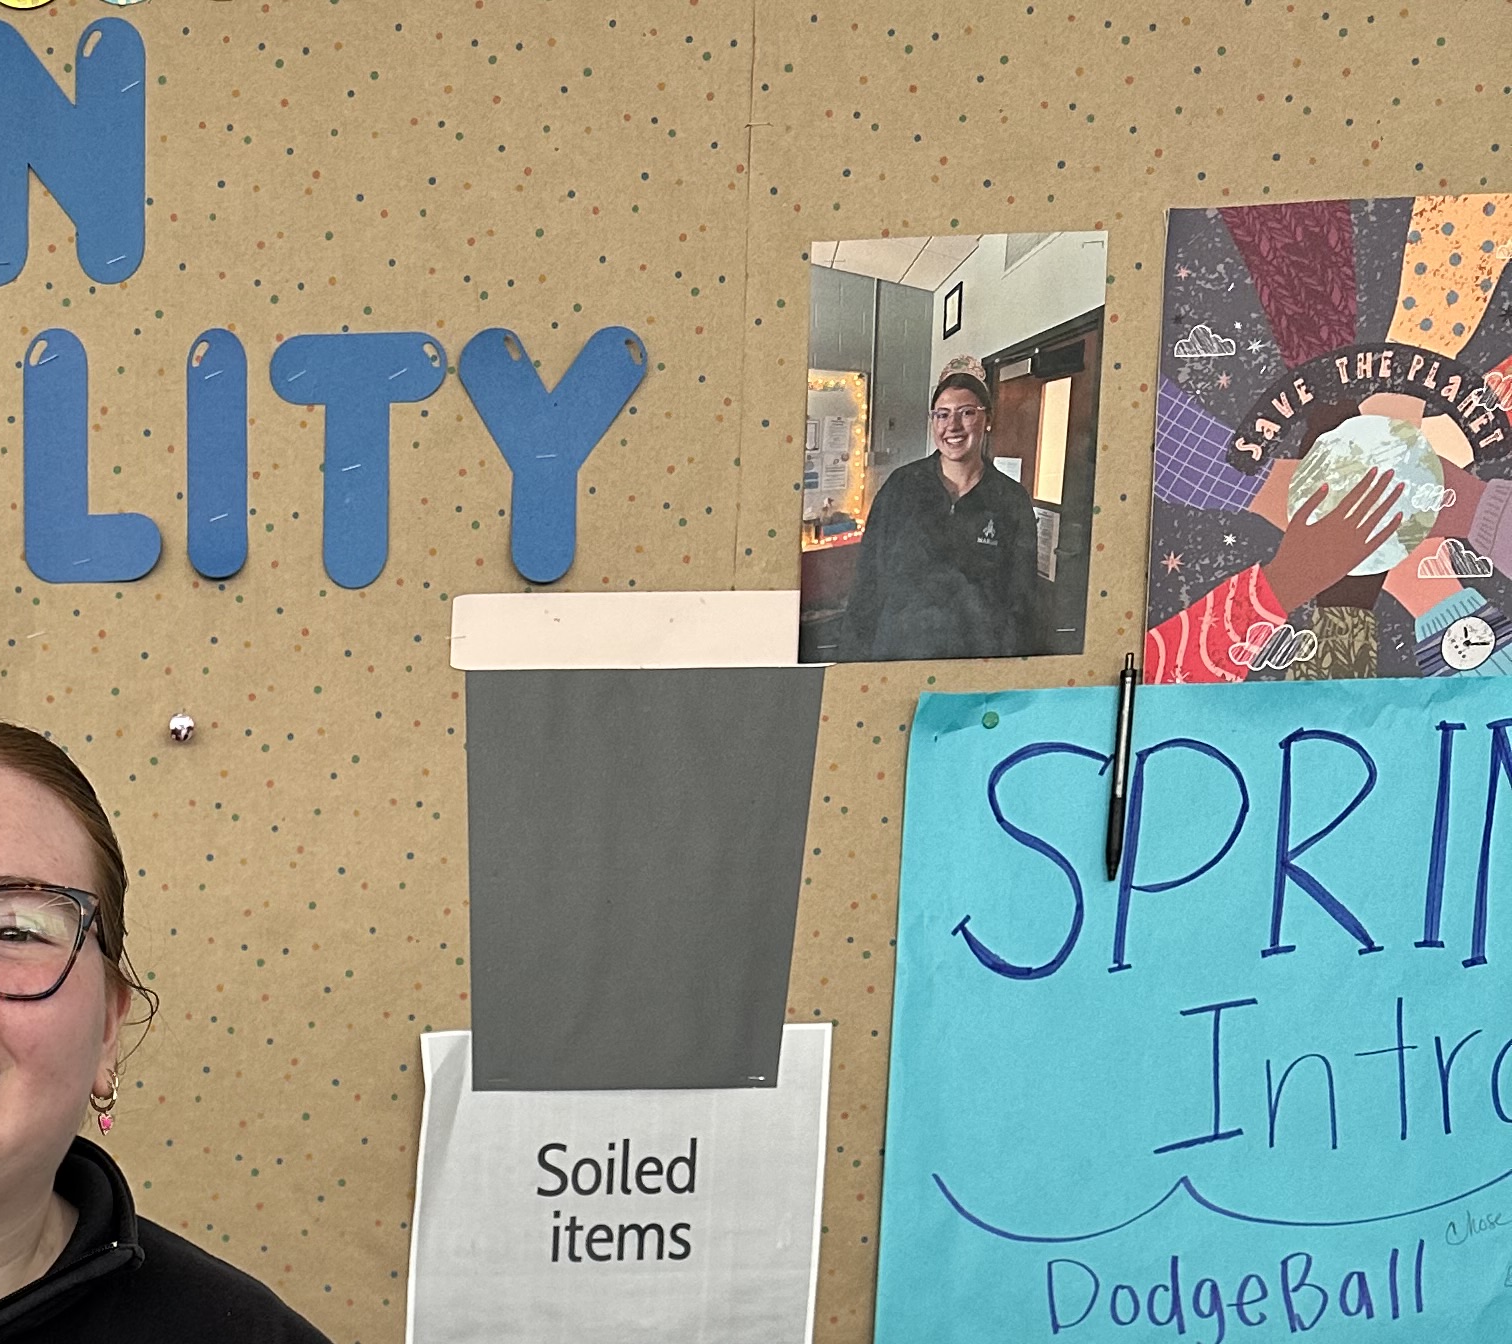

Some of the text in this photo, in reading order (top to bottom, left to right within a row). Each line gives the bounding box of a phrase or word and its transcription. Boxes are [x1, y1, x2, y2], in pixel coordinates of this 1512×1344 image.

[1335, 350, 1394, 384] THE
[537, 1137, 698, 1198] Soiled
[550, 1210, 692, 1264] items
